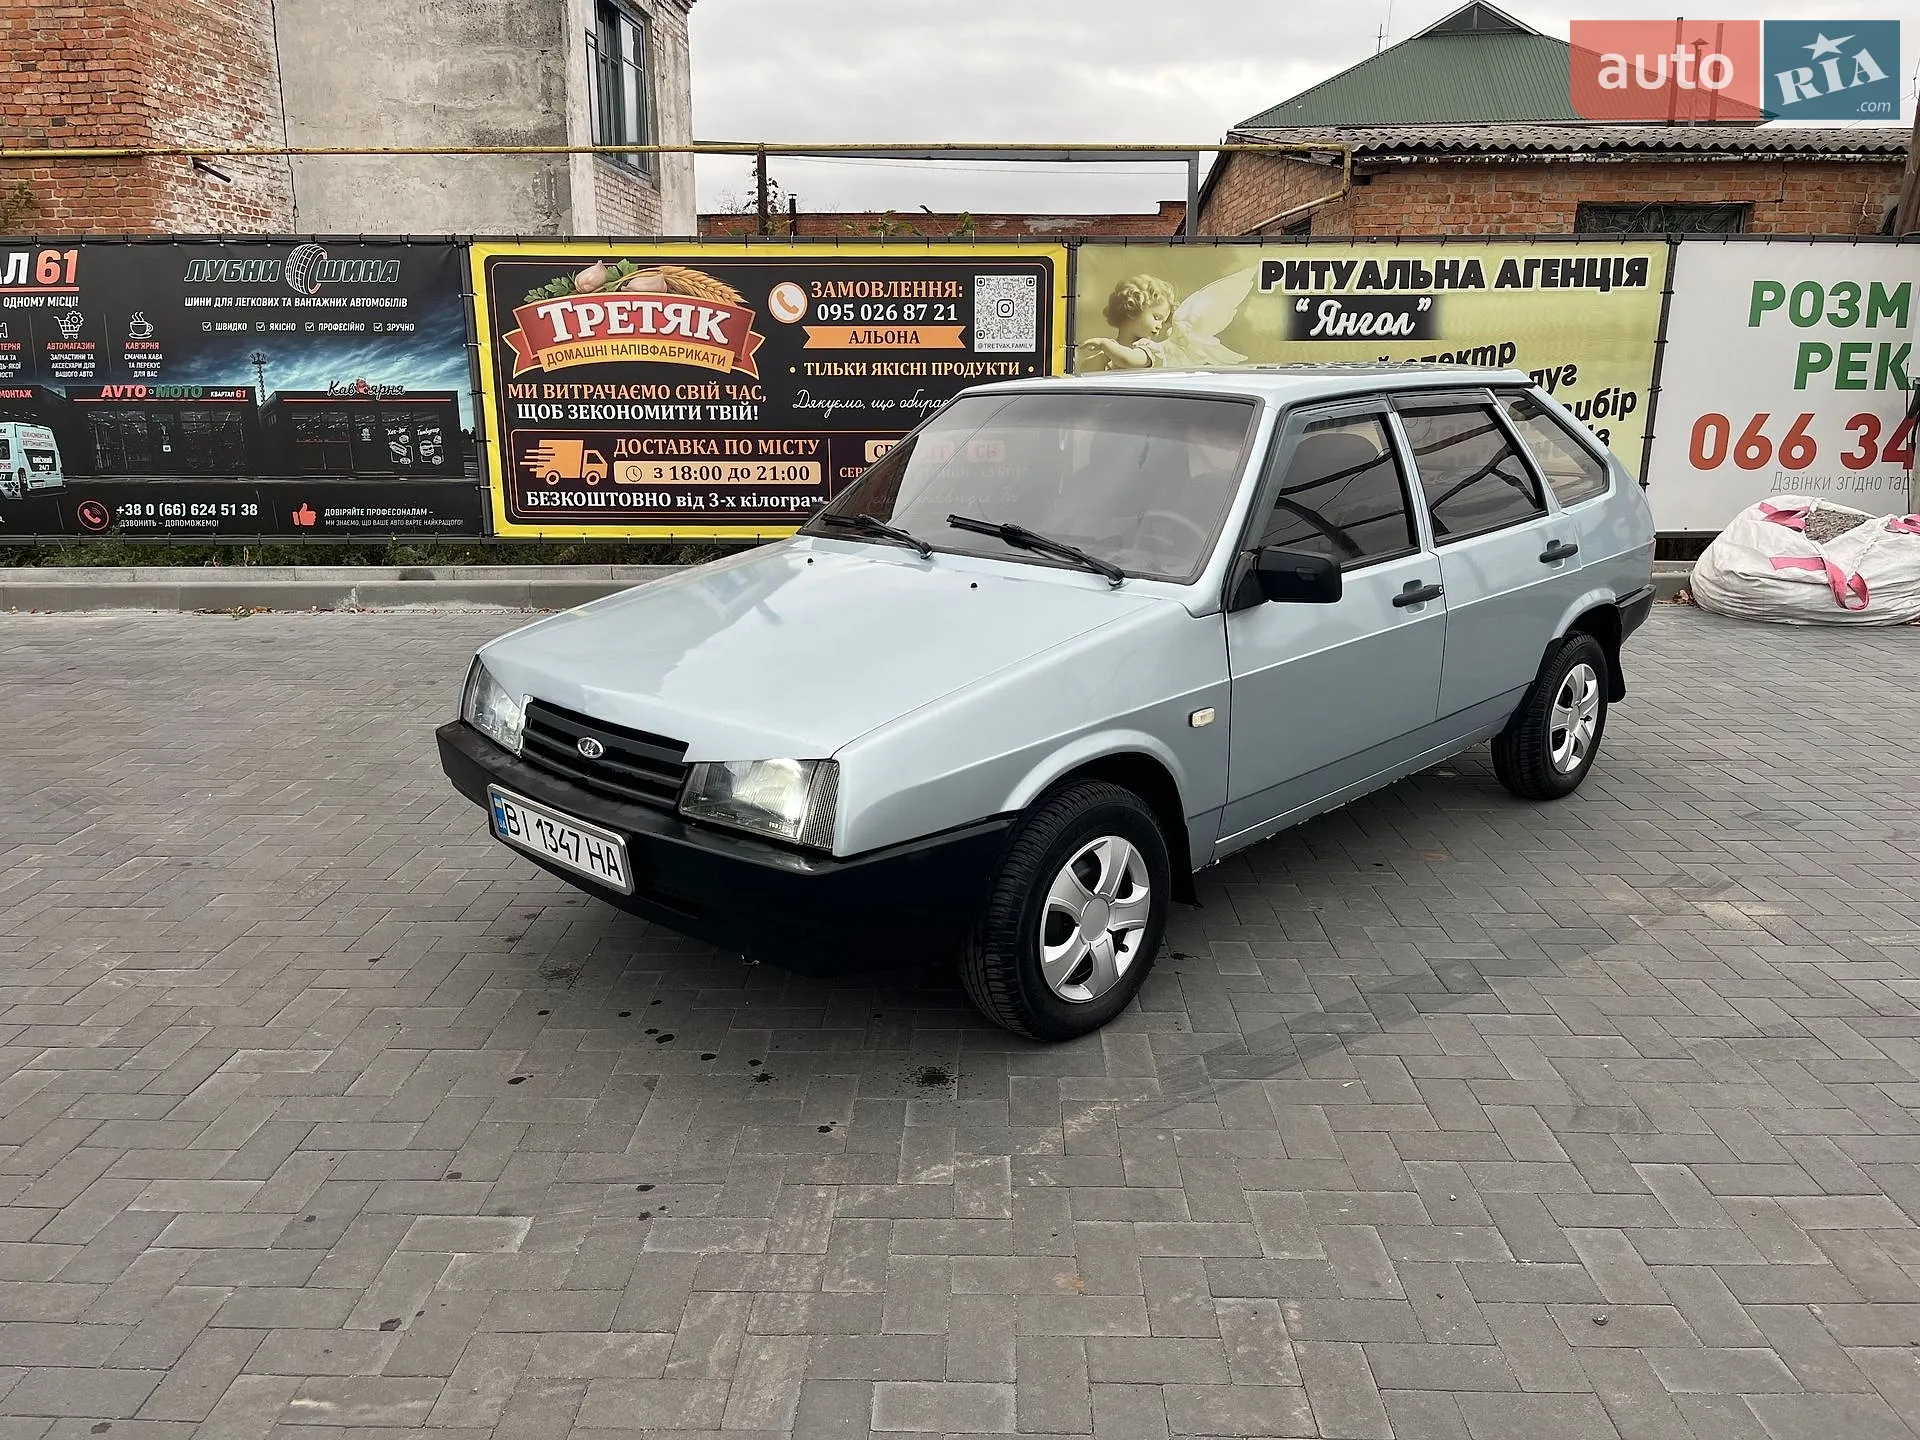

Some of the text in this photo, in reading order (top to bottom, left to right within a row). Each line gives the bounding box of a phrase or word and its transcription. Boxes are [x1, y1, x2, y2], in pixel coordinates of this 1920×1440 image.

[36, 249, 79, 285] 61
[184, 259, 400, 283] ЛУБНИ ШИНА
[1261, 257, 1648, 292] РИТУАЛЬНА АГЕНЦІЯ
[811, 281, 963, 299] ЗАМОВЛЕННЯ:
[3, 296, 79, 309] ОДНОМУ МІСЦІ!
[184, 297, 408, 308] ШИНИ ДЛЯ ЛЕГКОВИХ ТА ВАНТАЖНИХ АВТОМОБІЛІВ
[1748, 280, 1912, 329] РОЗМ
[817, 303, 958, 321] 095 026 87 21
[215, 322, 247, 332] ШВИДКО
[269, 322, 296, 332] ЯКІСНО
[318, 321, 365, 332] ПРОФЕСІЙНО
[386, 322, 415, 332] ЗРУЧНО
[537, 300, 731, 345] ТРЕТЯК
[848, 330, 920, 344] АЛЬОНА
[47, 342, 95, 350] АВТОМАГАЗИН
[87, 353, 94, 361] ТА
[546, 343, 726, 368] ДОМАШНІ НАПІВФАБРИКАТИ
[804, 361, 1020, 379] ТІЛЬКИ ЯКІСНІ ПРОДУКТИ
[236, 390, 246, 398] 61
[508, 381, 767, 403] МИ ВИТРАЧАЄМО СВІЙ ЧАС,
[517, 402, 759, 422] ЩОБ ЗЕКОНОМИТИ ТВІЙ!
[793, 389, 866, 418] Дякуємо,
[871, 399, 896, 411] що
[614, 438, 820, 457] ДОСТАВКА ПО МІСТУ
[1688, 413, 1817, 470] 066
[653, 466, 810, 482] з 18:00 до 21:00
[839, 467, 868, 478] СЕР
[1771, 471, 1831, 492] Дзвінки
[1836, 471, 1882, 491] згідно
[526, 491, 671, 507] БЕЗКОШТОВНО
[675, 493, 704, 508] від
[709, 493, 736, 507] 3-х
[116, 503, 258, 516] +38 0 (66) 624 51 38
[324, 507, 365, 517] ДОВІРЯЙТЕ
[165, 520, 219, 528] ДОПОМОЖЕМО!
[504, 802, 623, 882] BI 1347 HA
